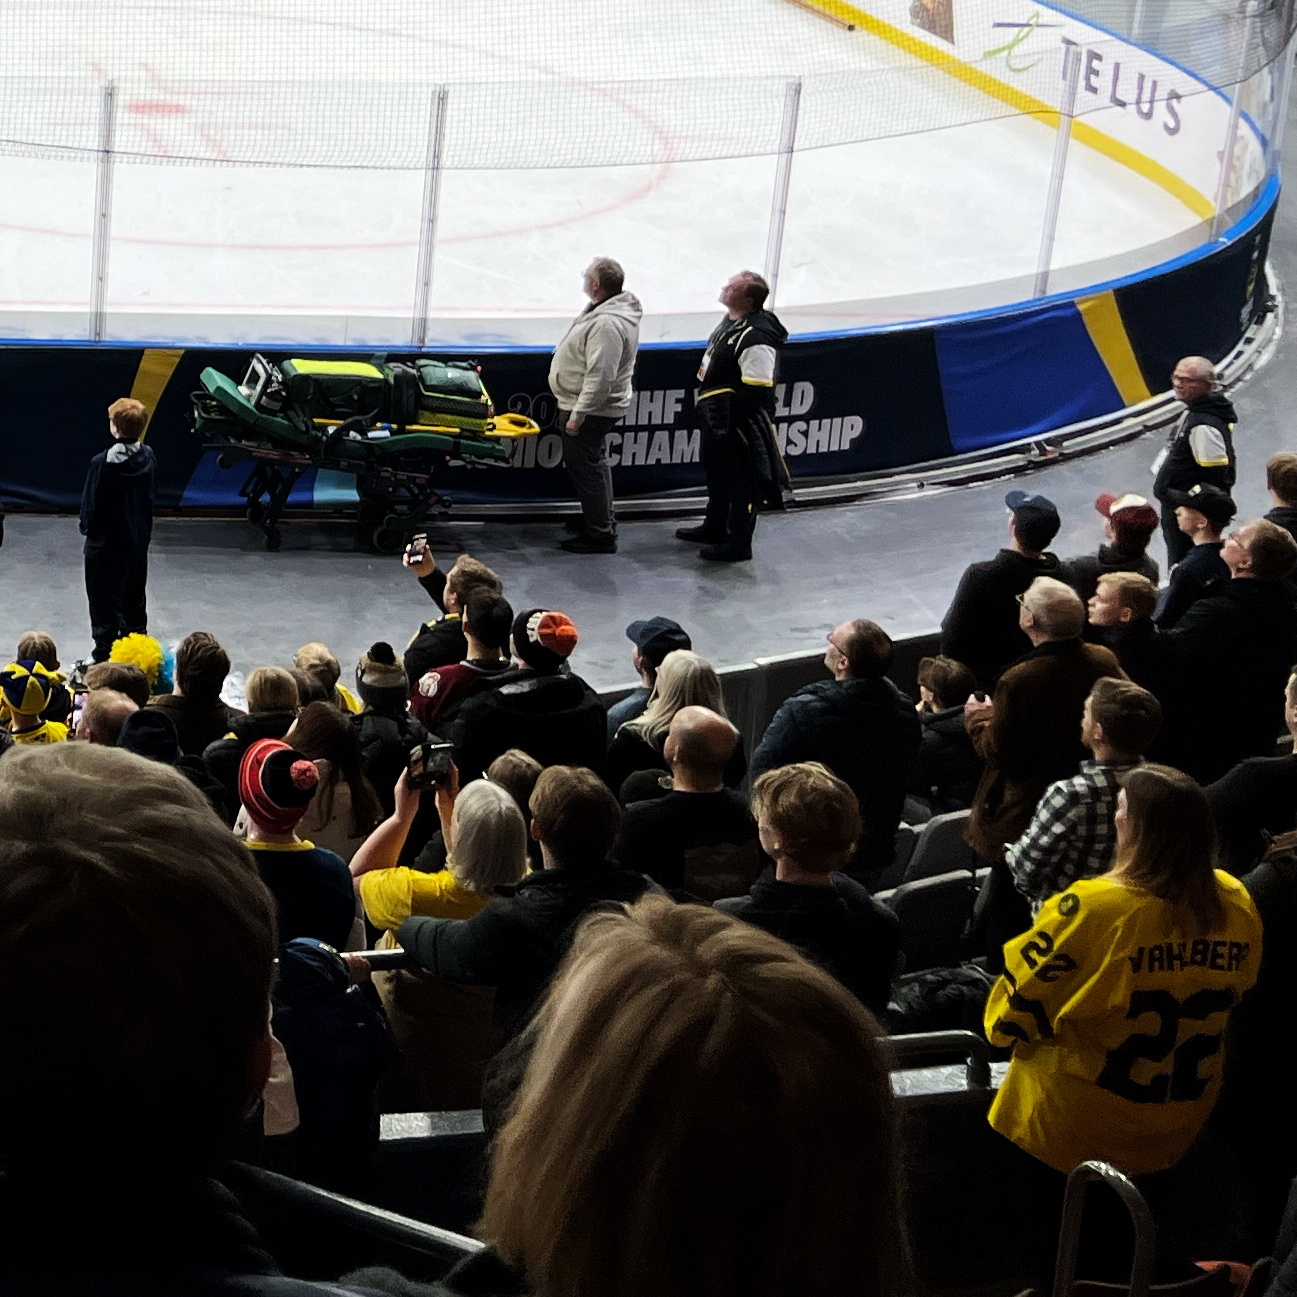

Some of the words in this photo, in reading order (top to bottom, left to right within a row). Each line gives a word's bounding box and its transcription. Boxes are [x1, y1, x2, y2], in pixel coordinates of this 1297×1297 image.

[1061, 35, 1184, 136] TELUS
[1020, 931, 1078, 983] 22
[1095, 987, 1239, 1104] 22
